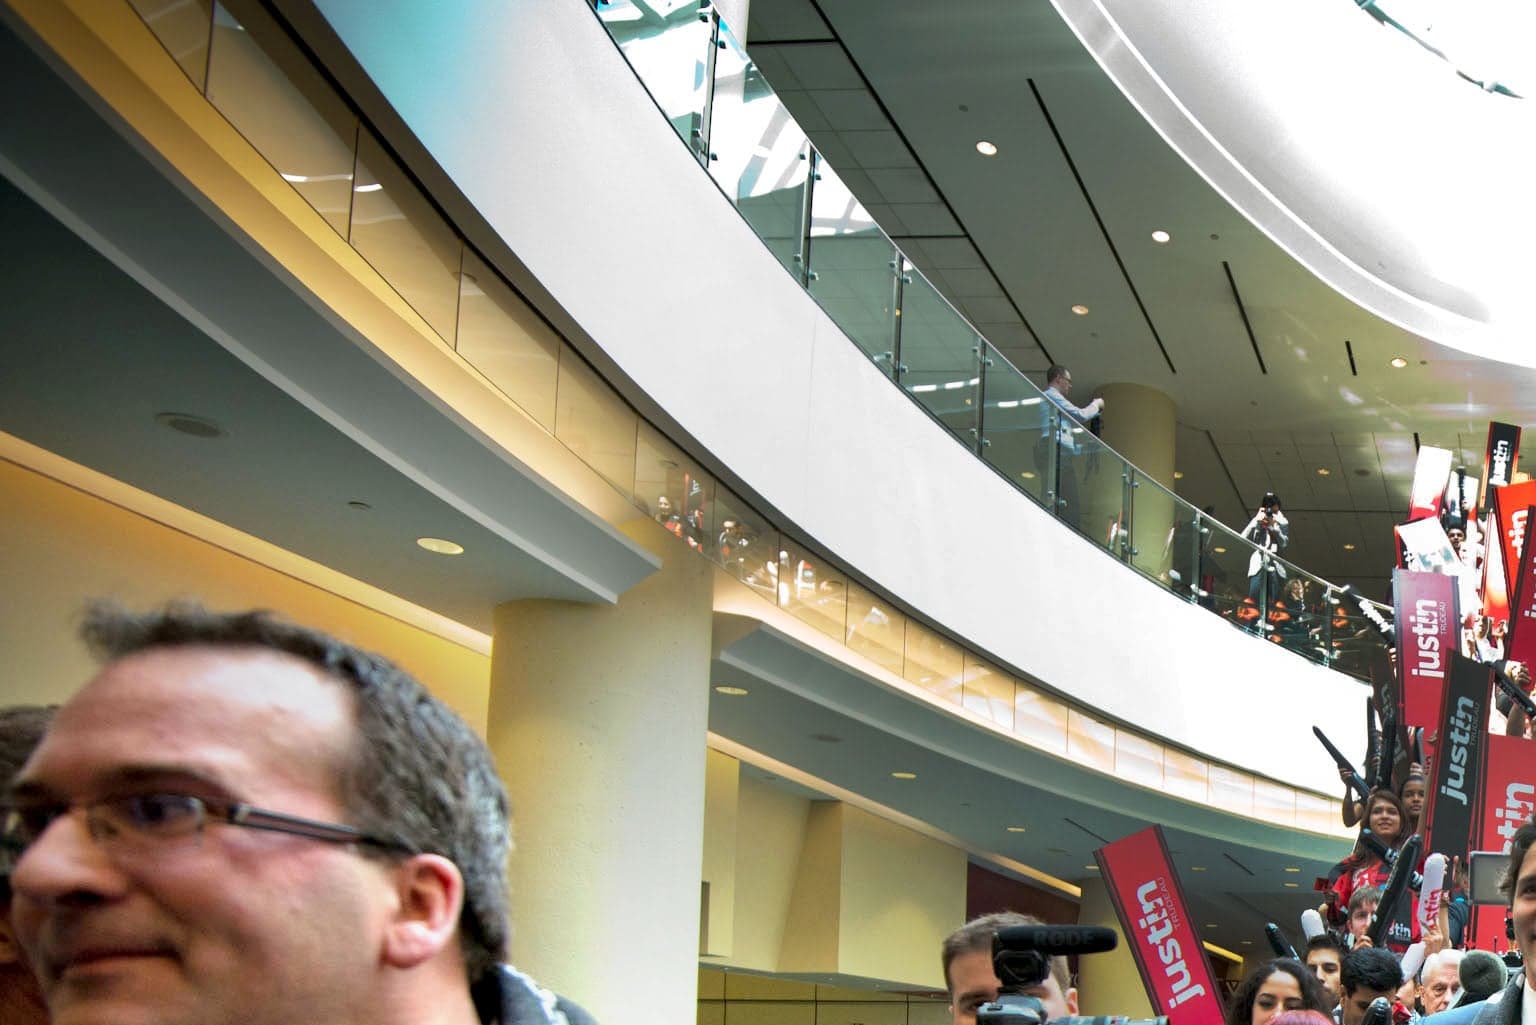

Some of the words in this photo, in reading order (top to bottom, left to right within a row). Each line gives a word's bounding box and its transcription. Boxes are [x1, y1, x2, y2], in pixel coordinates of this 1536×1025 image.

[1409, 599, 1445, 679] justin
[1440, 601, 1448, 634] TRUDEAU
[1441, 695, 1474, 806] justin
[1471, 702, 1481, 747] TRUDEAU
[1157, 876, 1181, 930] TRUDEAU
[1425, 888, 1441, 922] stin
[1136, 880, 1206, 1009] justin
